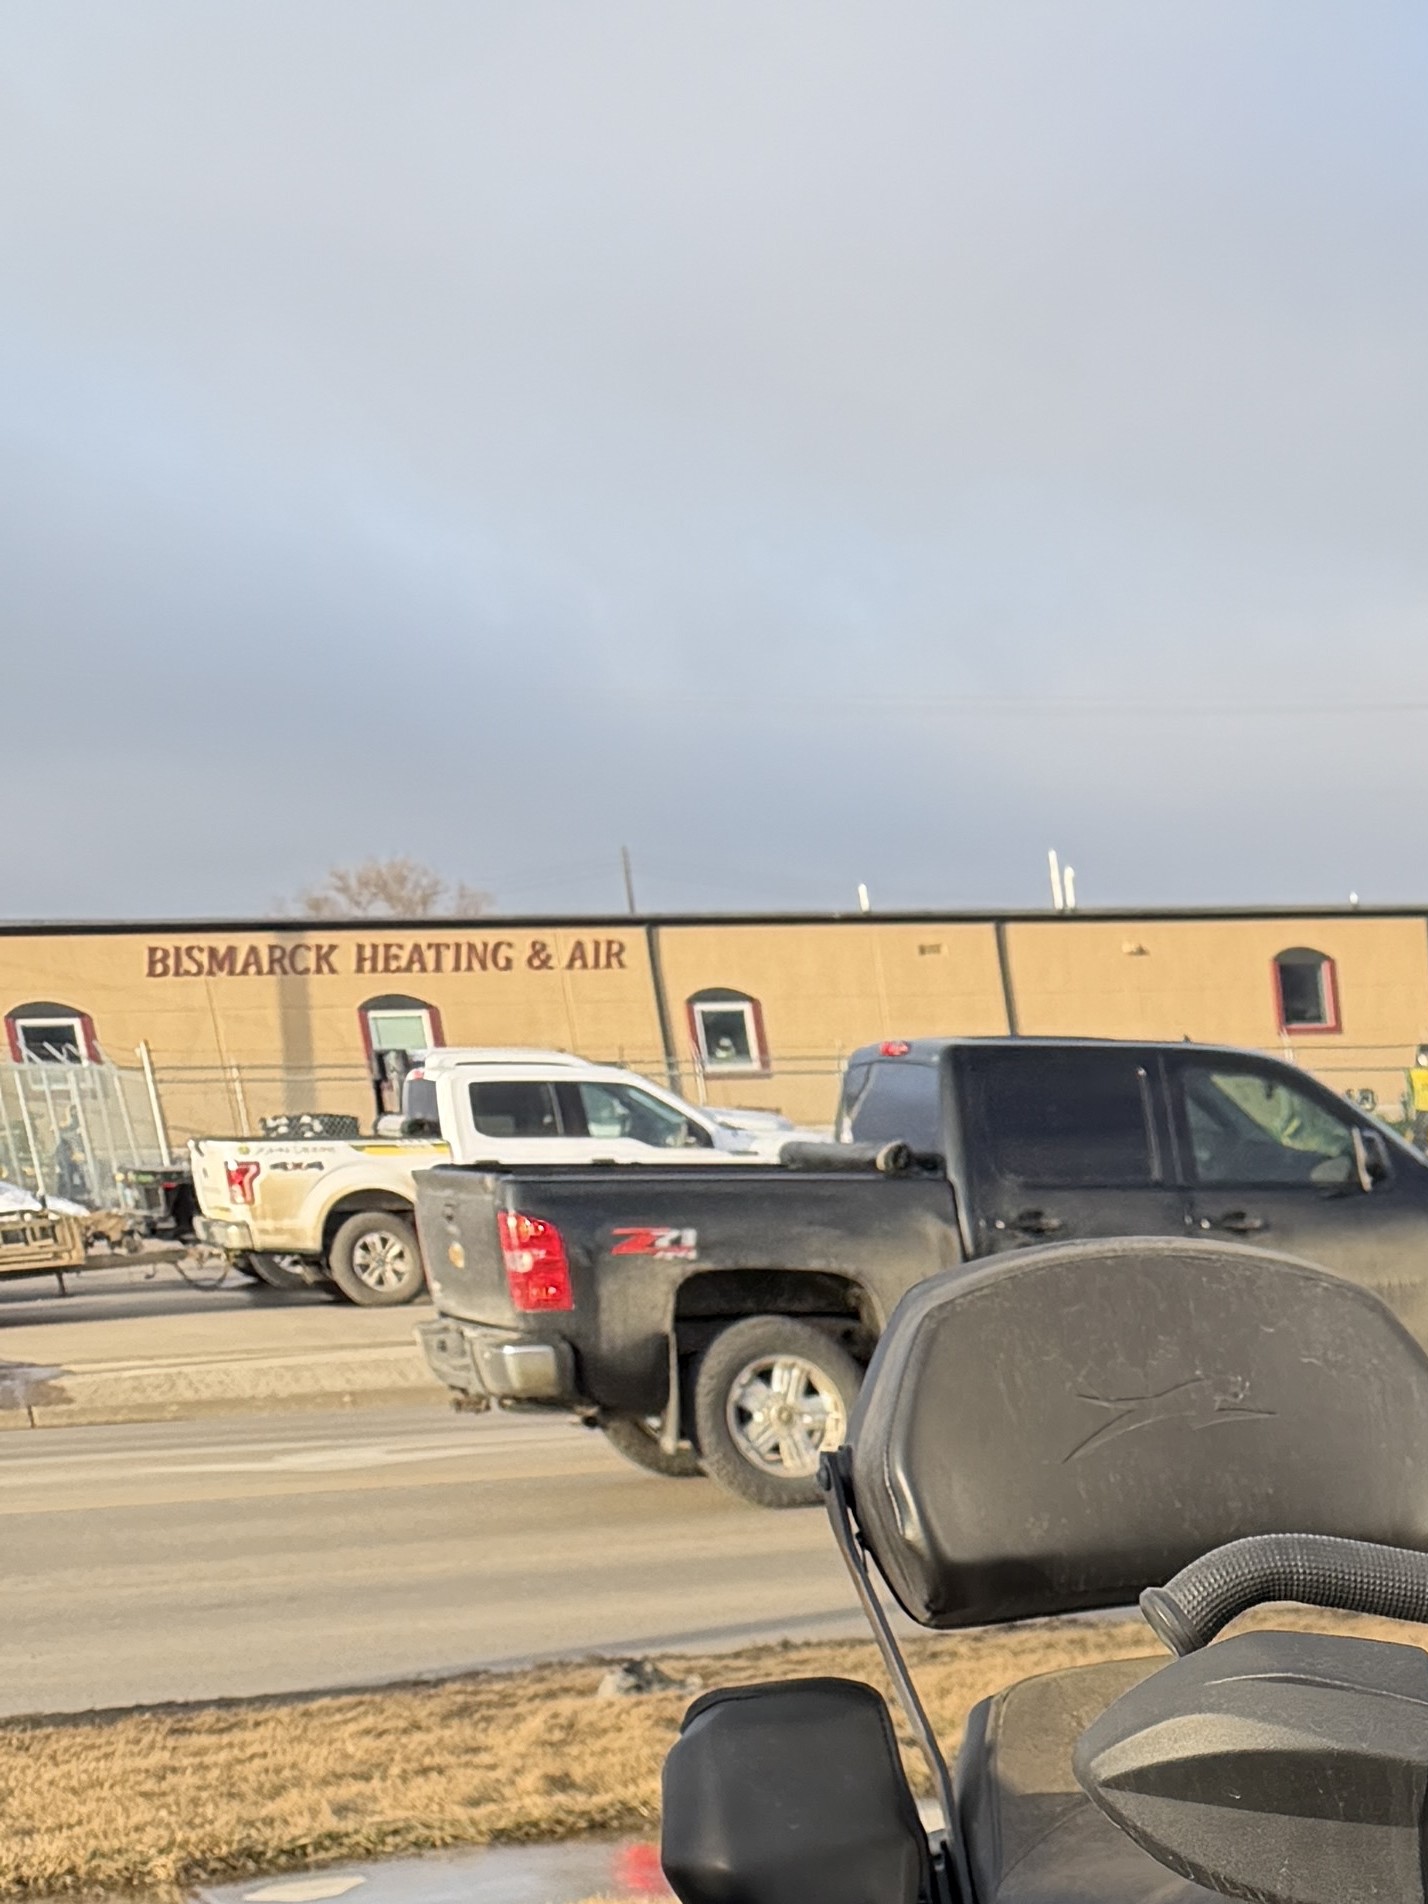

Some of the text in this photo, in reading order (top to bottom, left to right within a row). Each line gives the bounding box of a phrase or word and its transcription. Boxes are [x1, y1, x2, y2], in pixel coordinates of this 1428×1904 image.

[145, 939, 627, 977] BISMARCK HEATING & AIR
[610, 1226, 698, 1256] Z71
